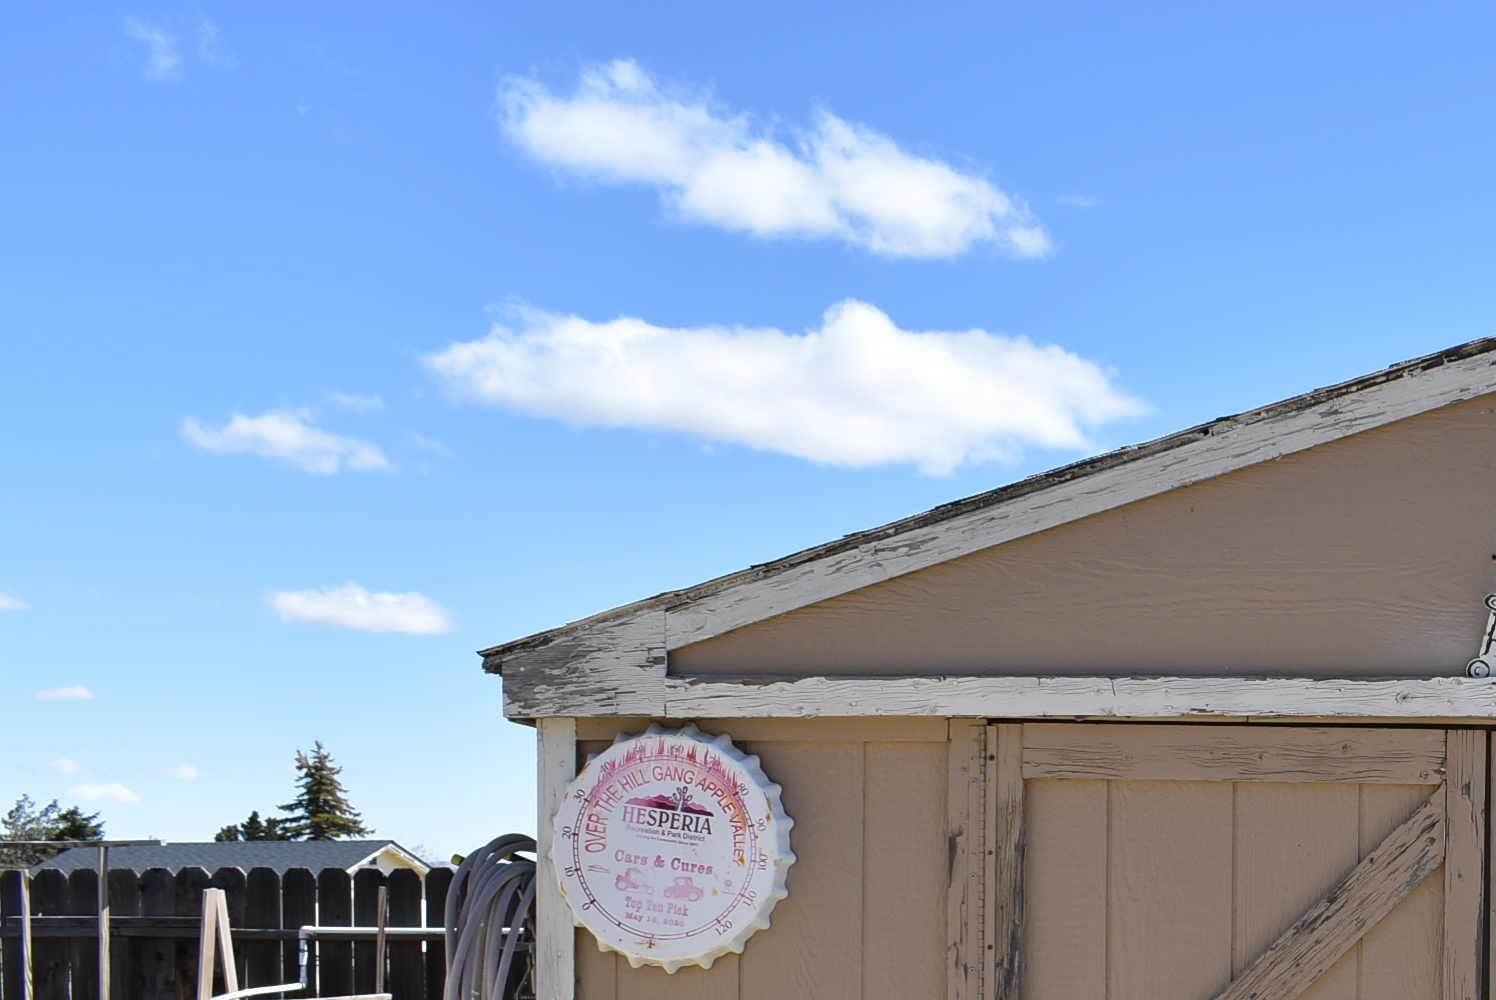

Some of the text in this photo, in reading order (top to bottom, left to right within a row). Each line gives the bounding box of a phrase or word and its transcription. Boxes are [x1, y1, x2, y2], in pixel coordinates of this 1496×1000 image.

[584, 765, 749, 867] OVER THE HILL GANG APPLE VALLEY
[623, 805, 713, 835] HESPERIA
[561, 825, 573, 840] 20
[682, 833, 706, 842] District
[614, 849, 714, 875] Cars & Cures
[715, 920, 734, 938] 120
